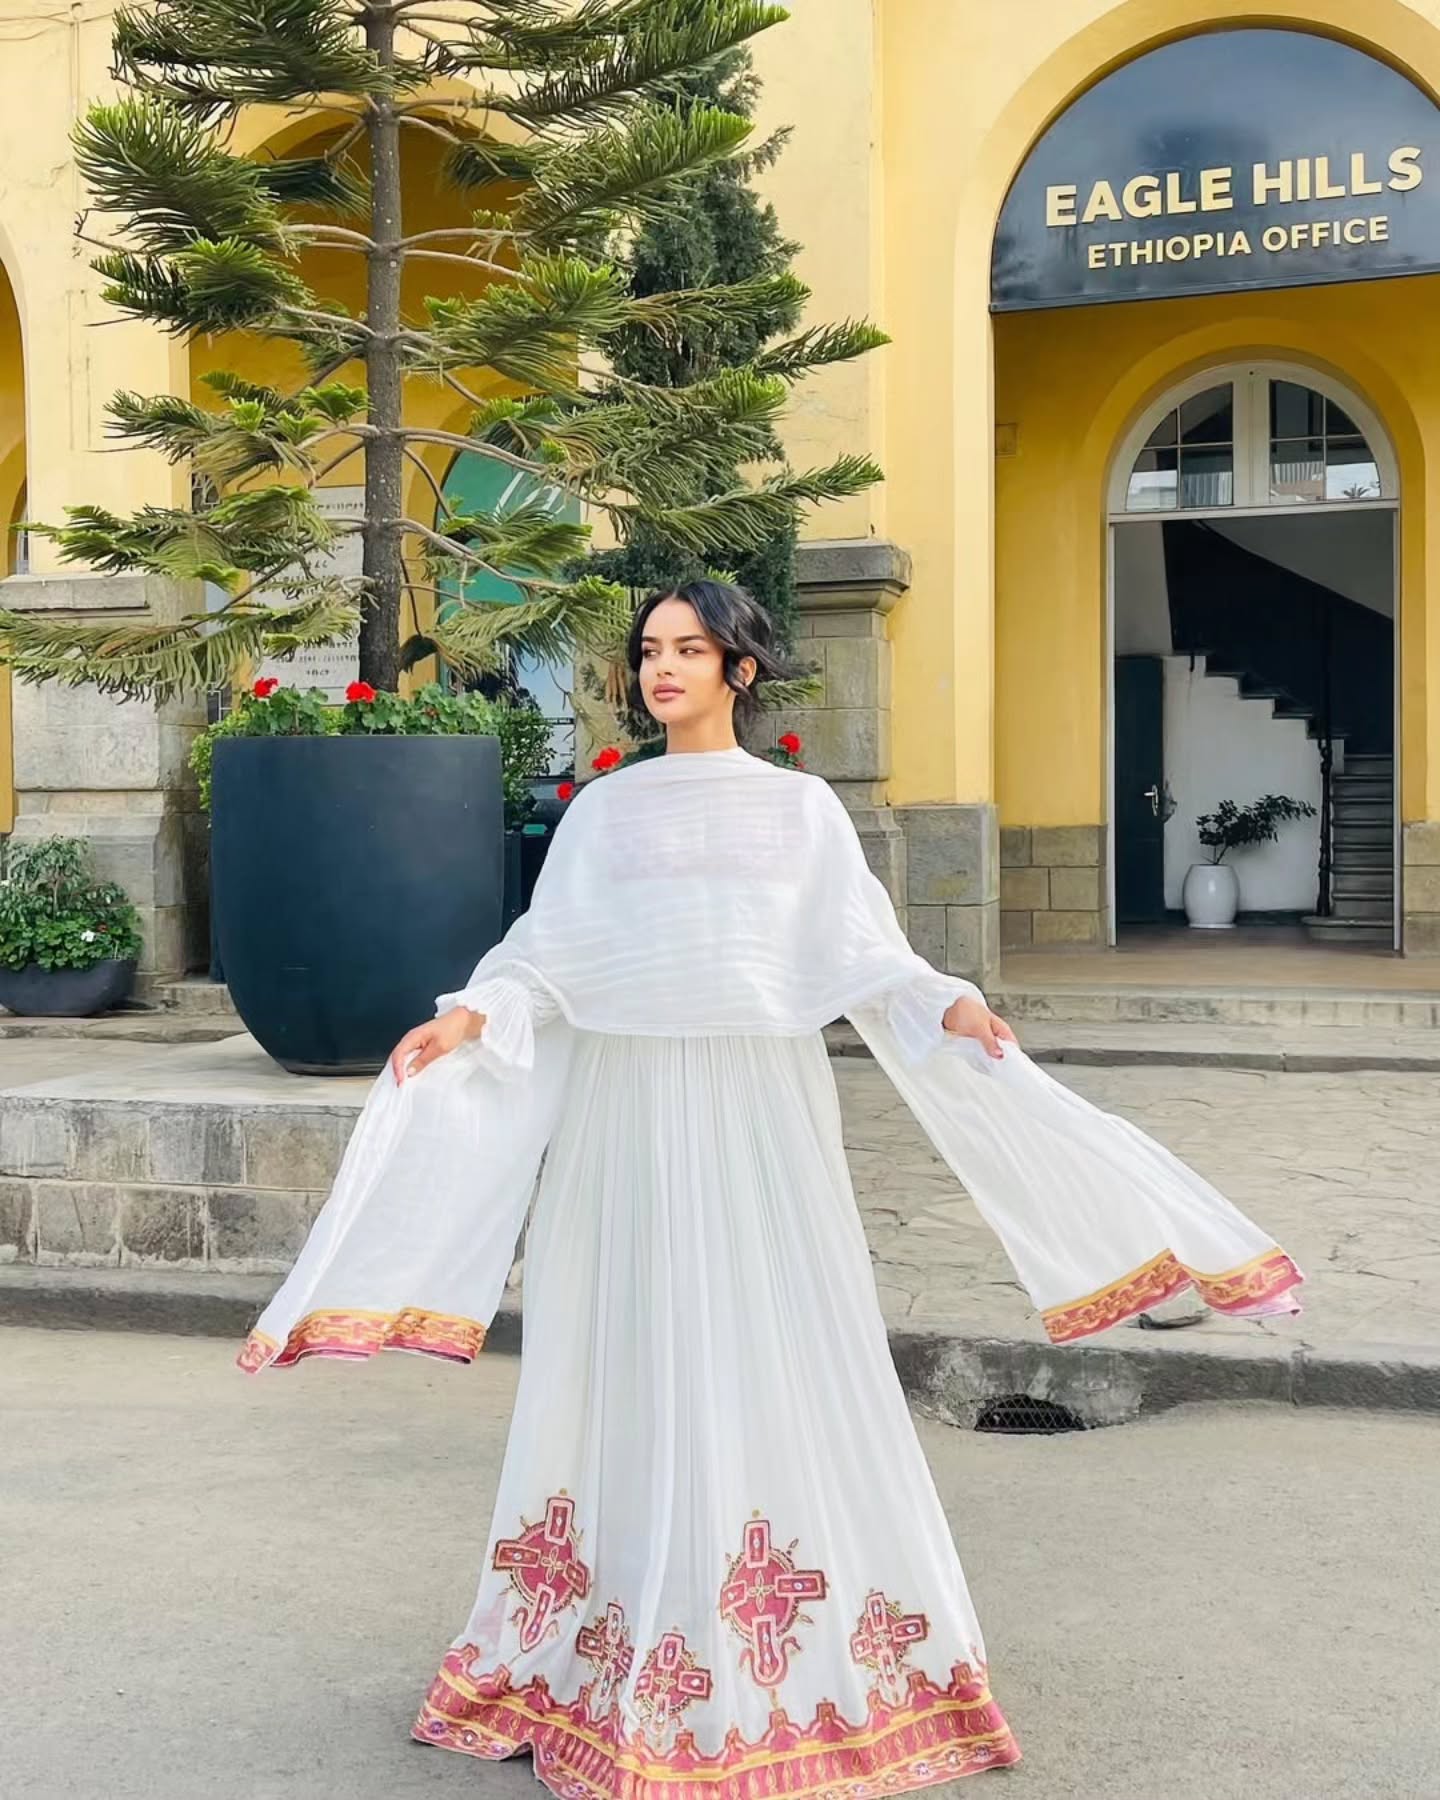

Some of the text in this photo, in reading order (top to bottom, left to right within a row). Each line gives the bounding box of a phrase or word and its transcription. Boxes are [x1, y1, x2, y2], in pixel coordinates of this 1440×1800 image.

[1045, 145, 1424, 227] EAGLE HILLS
[1087, 215, 1389, 269] ETHIOPIA OFFICE
